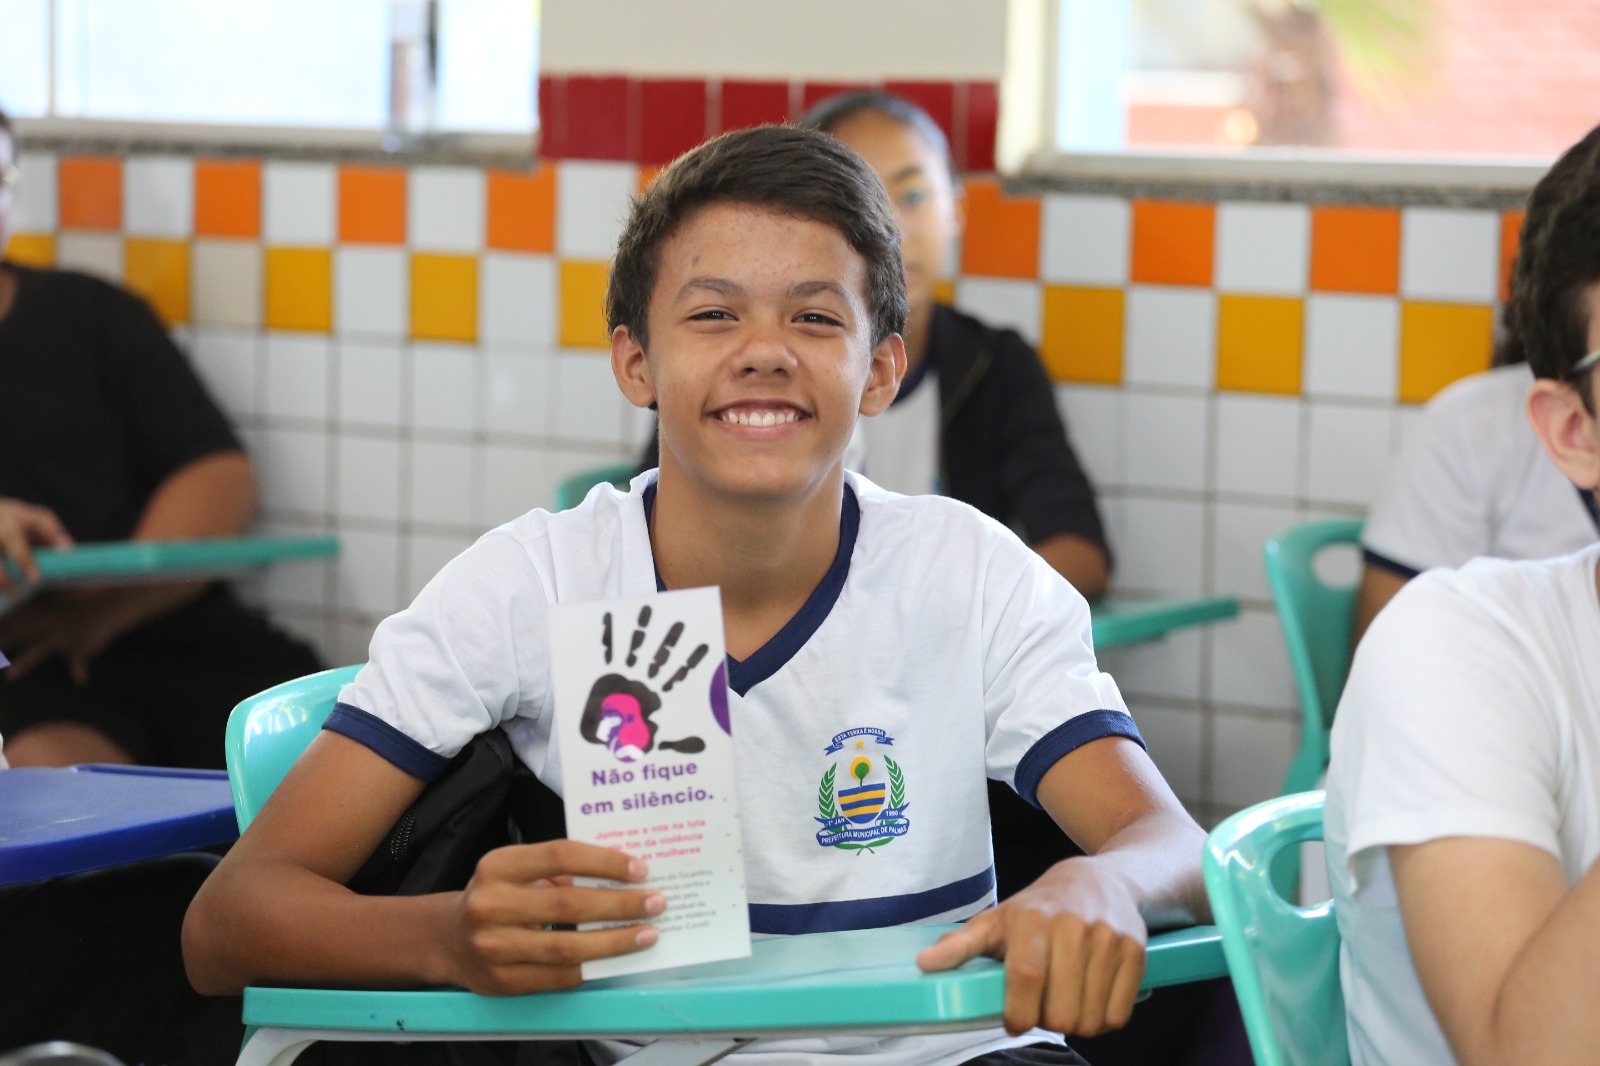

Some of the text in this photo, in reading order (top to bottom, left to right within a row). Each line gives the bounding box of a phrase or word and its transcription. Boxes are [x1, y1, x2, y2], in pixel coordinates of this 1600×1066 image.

[834, 733, 847, 742] ESTA
[847, 728, 863, 737] TERRA
[867, 728, 884, 736] NOSSA
[592, 763, 697, 786] Não fique
[581, 786, 714, 815] em silêncio.
[596, 828, 639, 840] Junte-se
[652, 824, 669, 833] nós
[672, 822, 684, 831] na
[687, 819, 706, 829] luta
[834, 817, 845, 825] JAN
[626, 840, 641, 849] fim
[660, 832, 704, 845] violência
[821, 831, 852, 844] PREFEITURA
[852, 828, 880, 838] MUNICIPAL
[888, 825, 907, 835] PALMAS
[655, 846, 701, 859] mulheres
